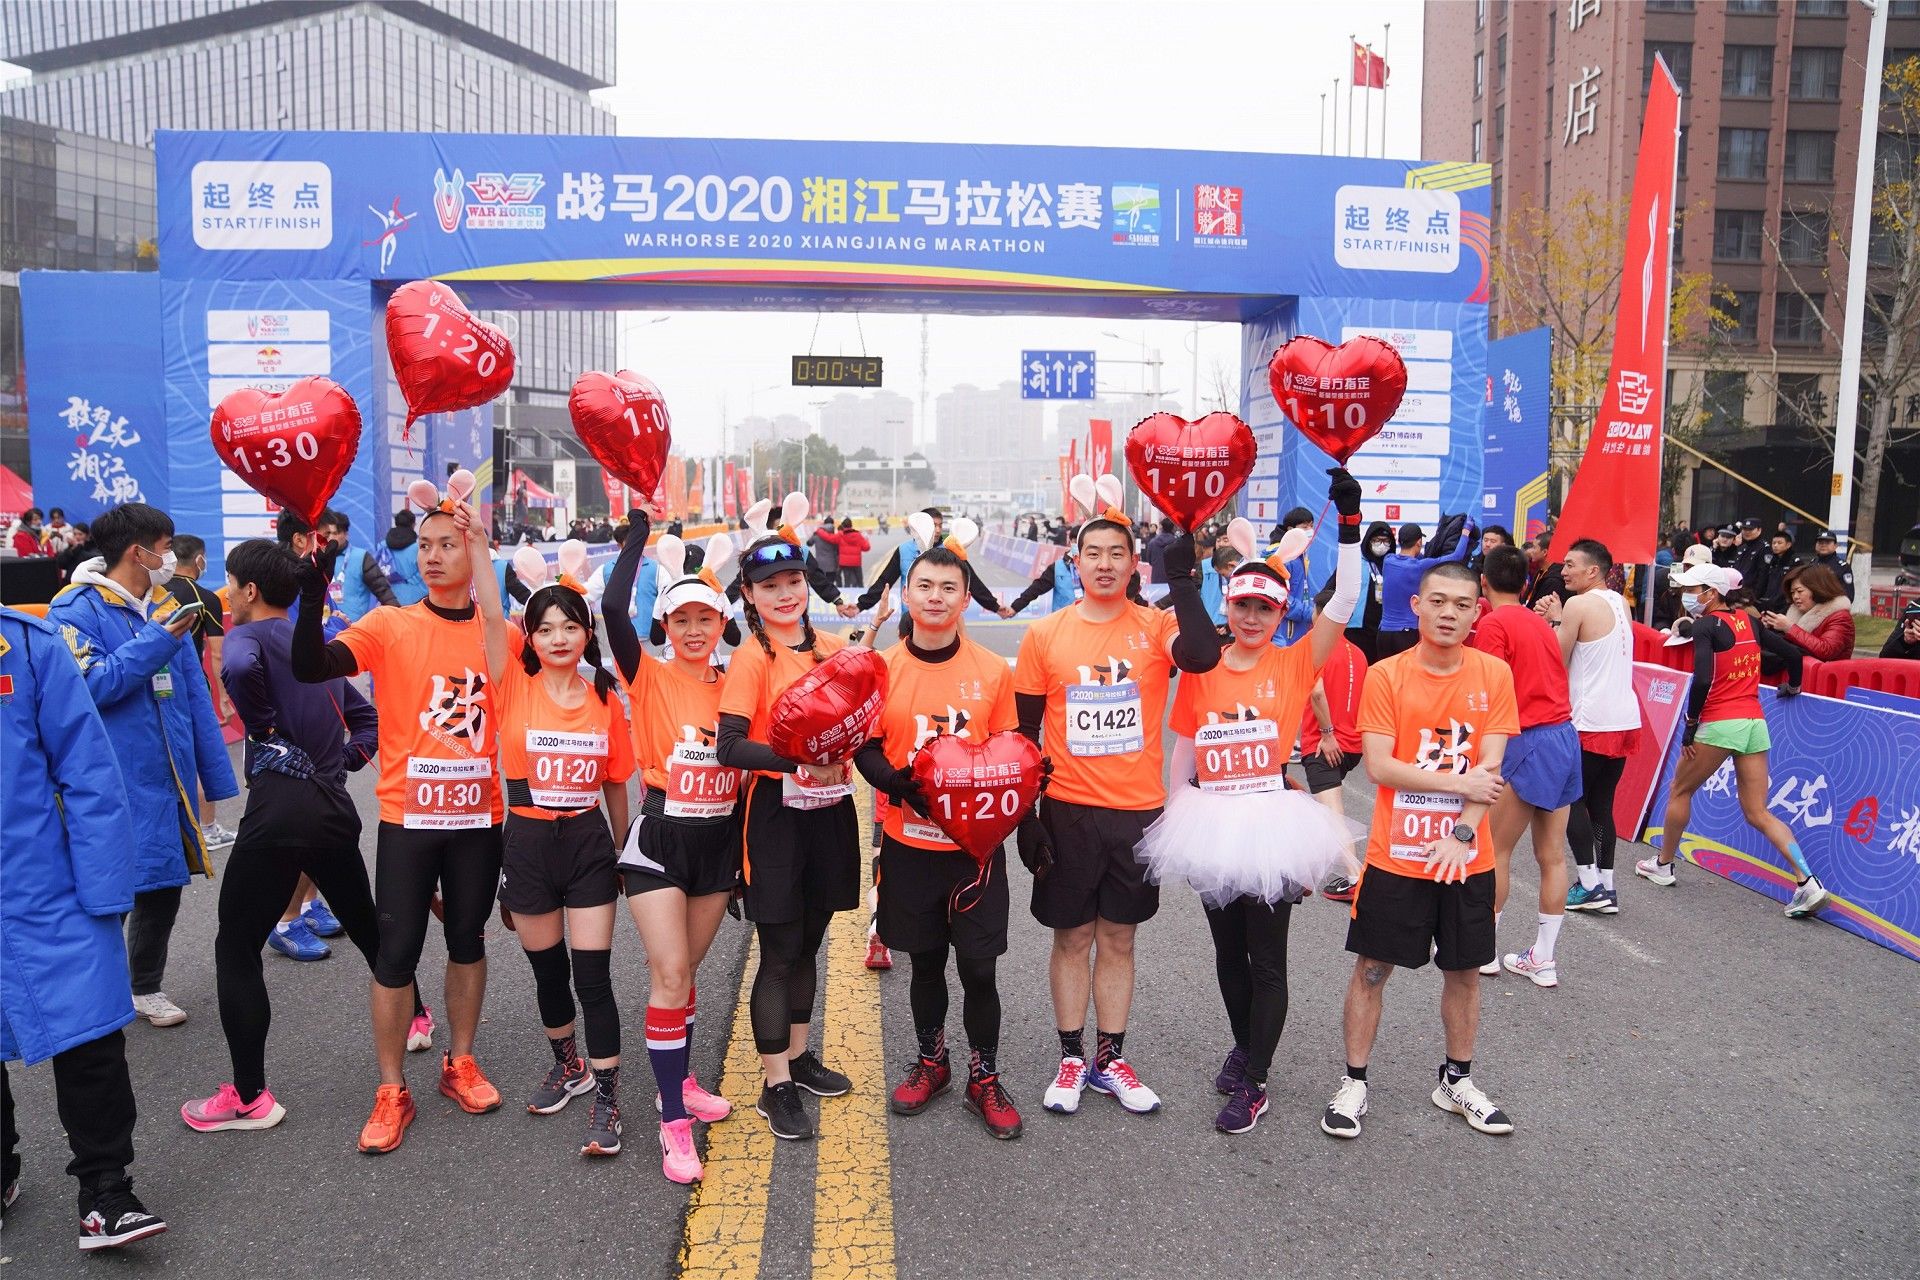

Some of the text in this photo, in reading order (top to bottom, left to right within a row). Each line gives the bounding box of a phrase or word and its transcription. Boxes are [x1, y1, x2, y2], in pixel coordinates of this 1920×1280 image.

[203, 182, 320, 209] 起终点
[202, 217, 321, 229] START/FINISH
[468, 207, 543, 217] WAR HORSE
[1345, 205, 1450, 235] 起终点
[625, 233, 1046, 253] WARHORSE 2020 XIANGJIANG MARATHON
[1343, 238, 1450, 253] START/FINISH
[422, 313, 496, 378] 1:20
[798, 362, 877, 382] 0:00:42
[1320, 377, 1370, 390] 官方指定
[261, 402, 314, 424] 官方指定
[1286, 397, 1366, 429] 1:10
[233, 431, 318, 474] 1:30
[1182, 446, 1230, 458] 官方指定
[1146, 468, 1225, 497] 1:10
[843, 690, 880, 729] 官方指定
[1077, 708, 1136, 731] C1422
[536, 756, 598, 783] 01:20
[973, 762, 1021, 779] 官方指定
[1206, 744, 1269, 773] 01:10
[417, 783, 481, 807] 01:30
[680, 770, 735, 796] 01:00
[938, 789, 1019, 820] 1:20
[1404, 814, 1459, 839] 01:0
